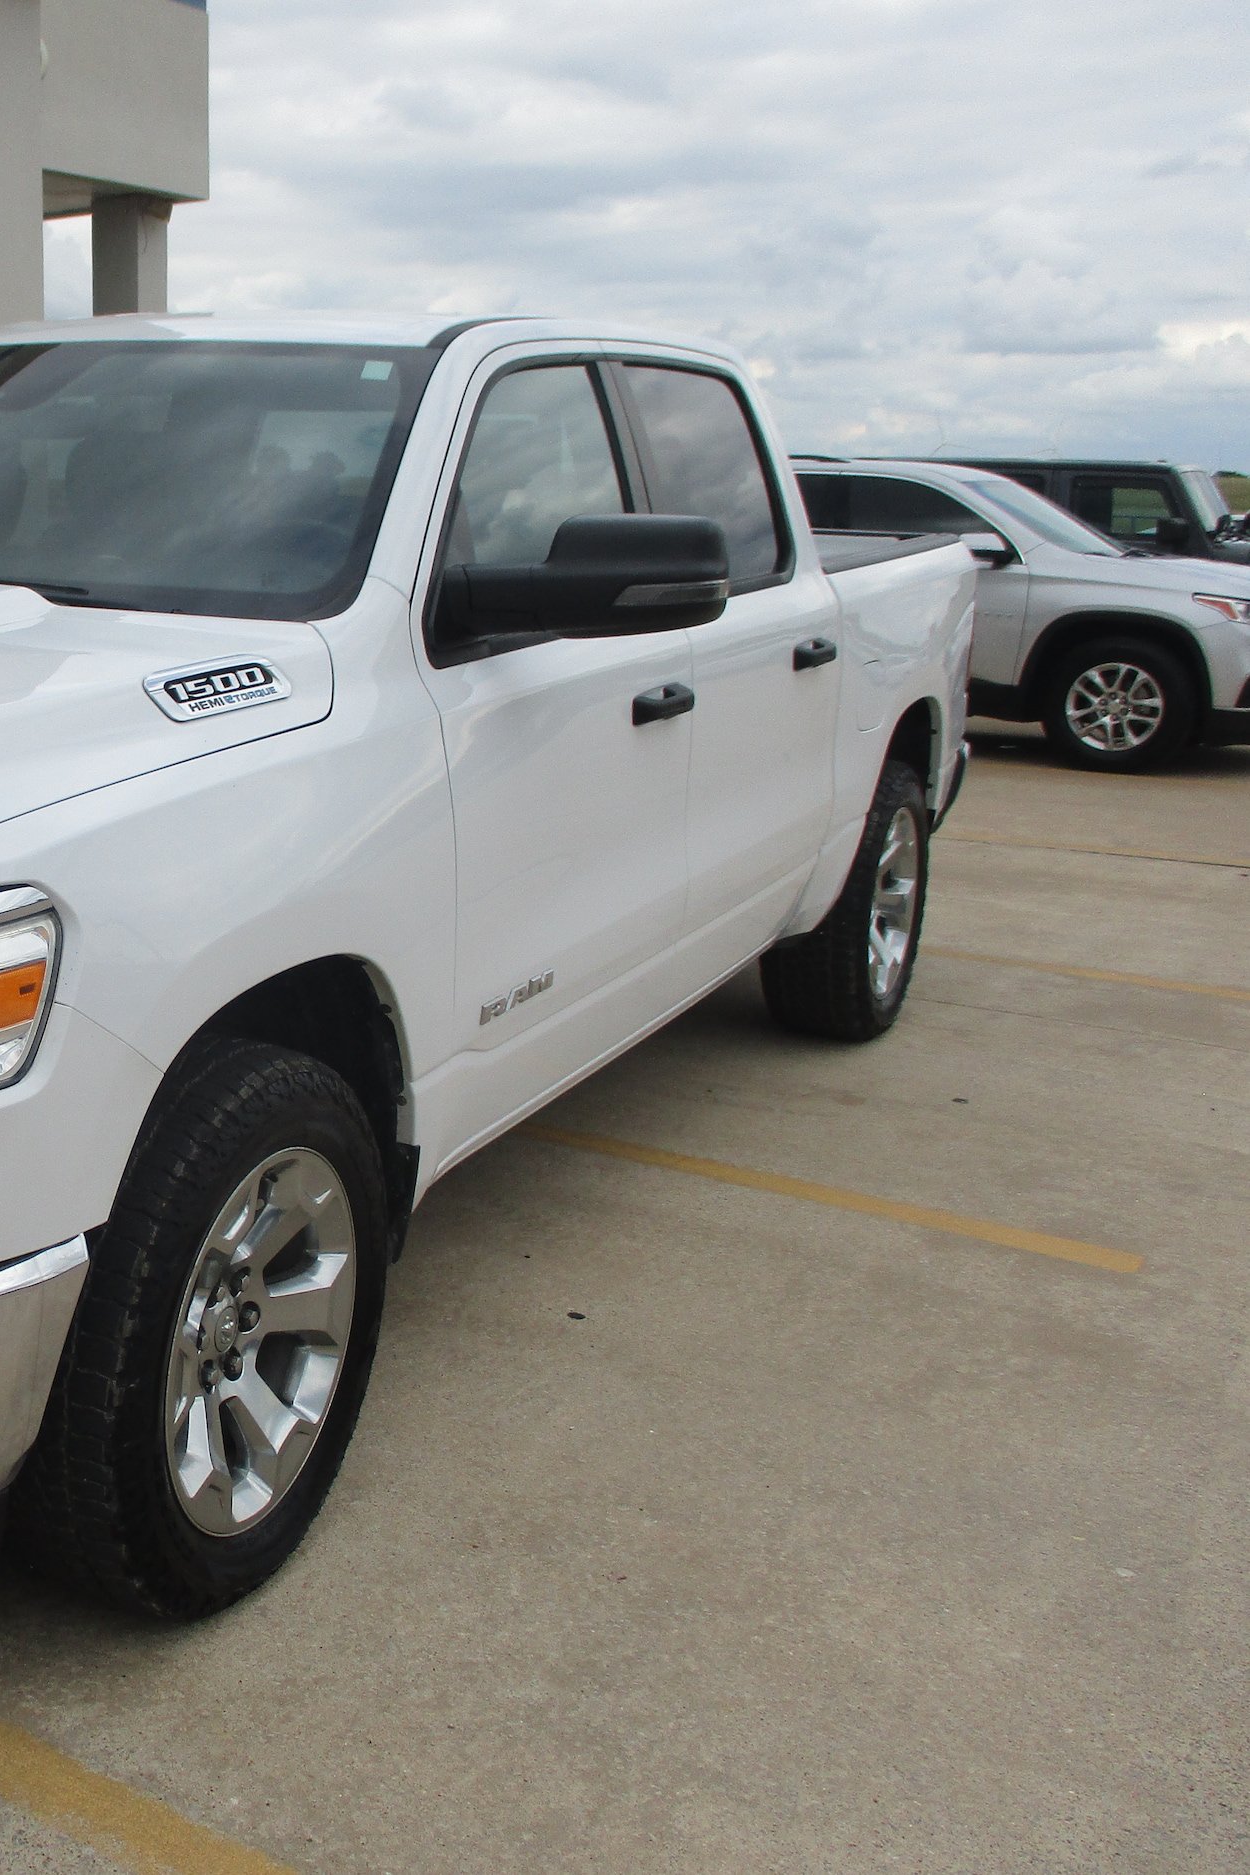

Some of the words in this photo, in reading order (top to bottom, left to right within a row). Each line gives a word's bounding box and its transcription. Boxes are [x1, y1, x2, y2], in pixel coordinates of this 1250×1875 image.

[168, 666, 266, 702] 1500
[188, 696, 225, 713] HEMI
[479, 967, 554, 1026] RAM
